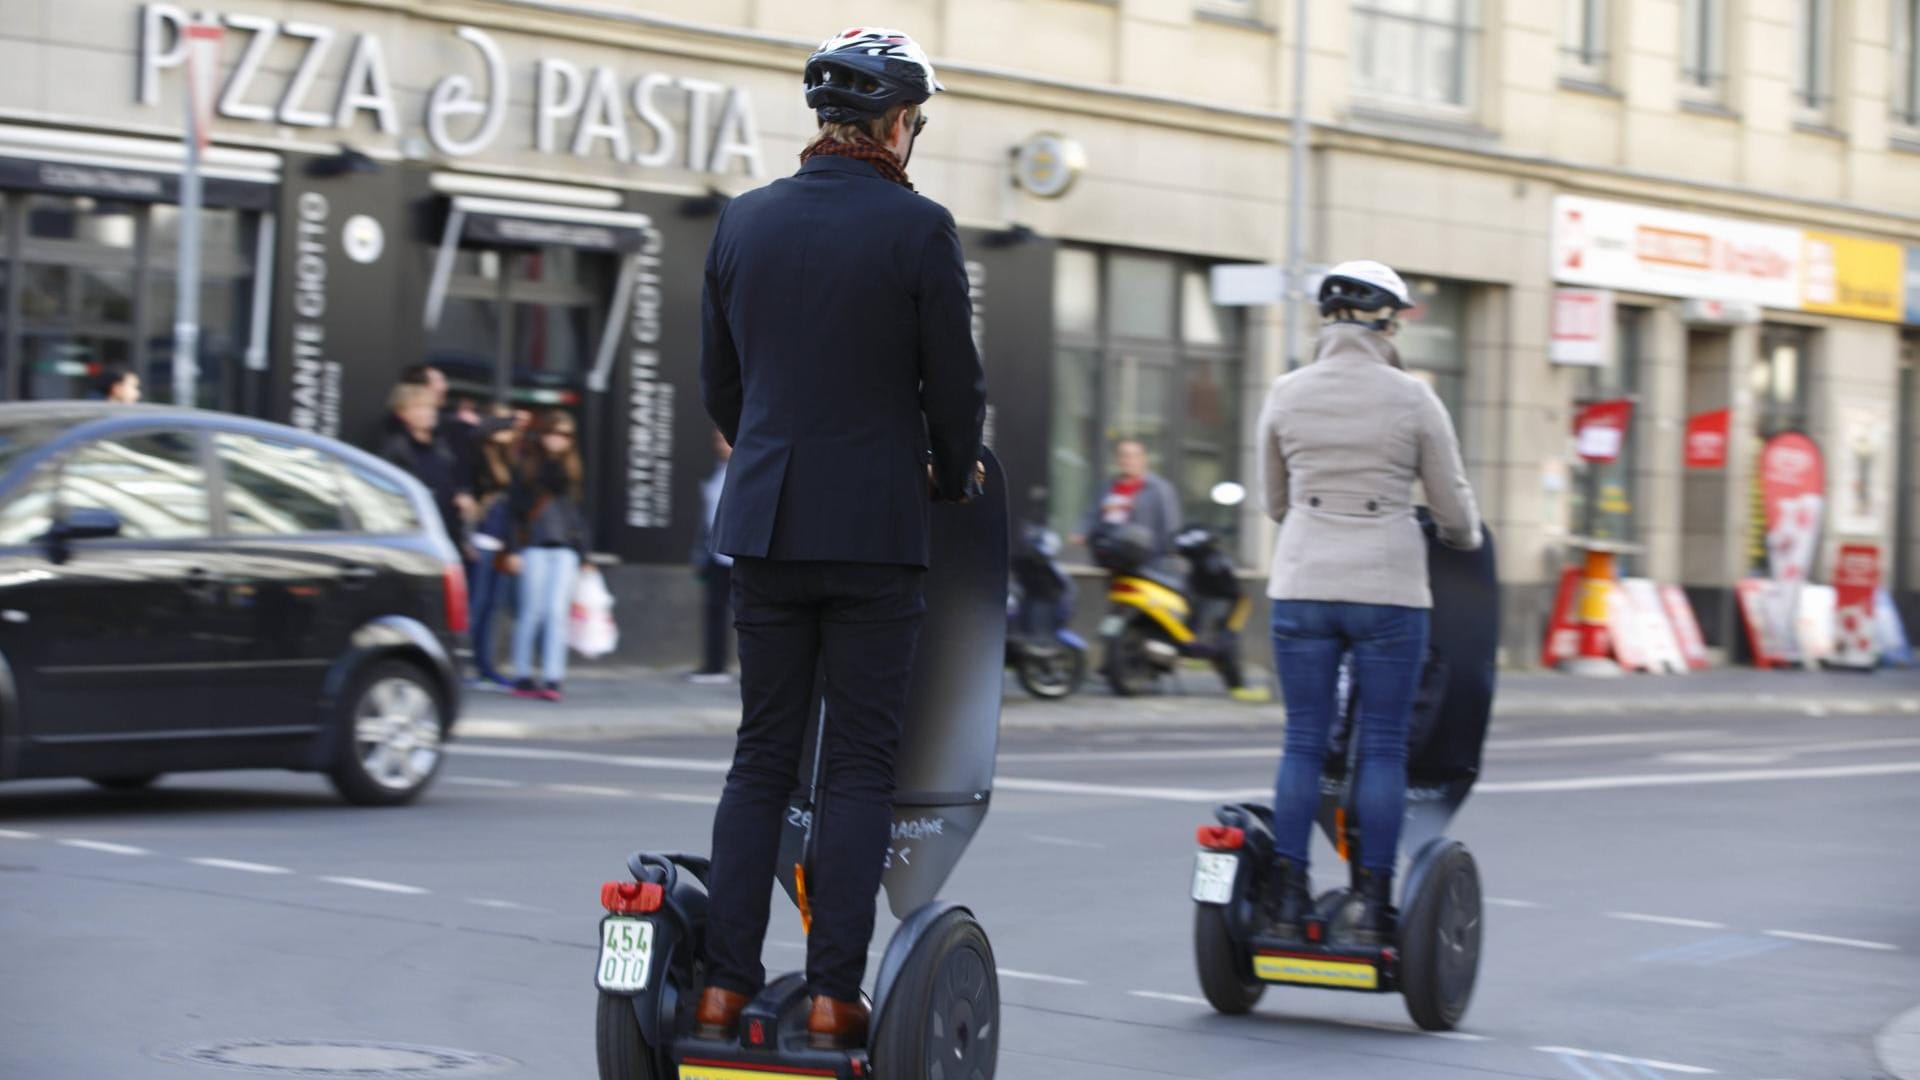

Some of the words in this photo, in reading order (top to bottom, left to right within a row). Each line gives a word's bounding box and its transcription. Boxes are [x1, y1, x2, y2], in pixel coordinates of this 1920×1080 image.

[137, 3, 402, 135] PZZA
[536, 57, 767, 179] PASTA
[295, 191, 329, 318] GIOTTO
[290, 322, 326, 436] RANTE
[606, 924, 648, 953] 454
